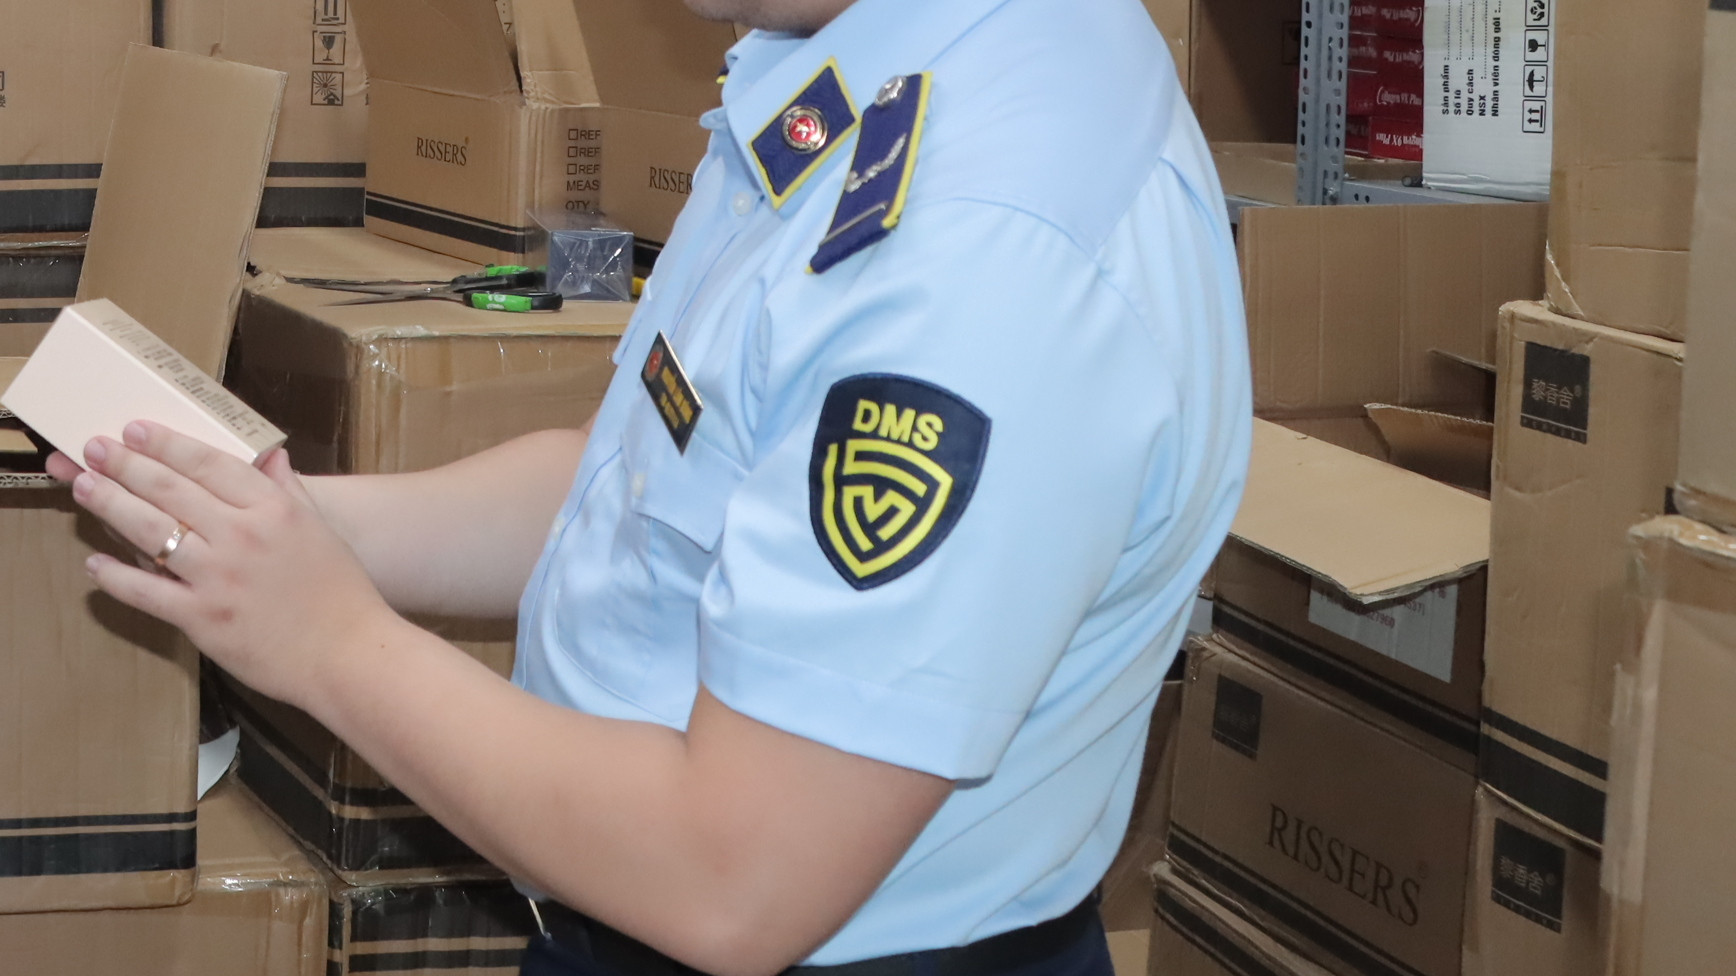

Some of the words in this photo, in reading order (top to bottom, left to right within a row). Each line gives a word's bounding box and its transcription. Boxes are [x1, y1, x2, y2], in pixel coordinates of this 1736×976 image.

[1466, 69, 1474, 94] cách
[1491, 65, 1499, 87] viên
[1491, 90, 1499, 117] Nhân
[416, 137, 467, 166] RISSERS
[649, 167, 693, 195] RISSER
[852, 398, 944, 452] DMS
[1265, 802, 1421, 927] RISSERS
